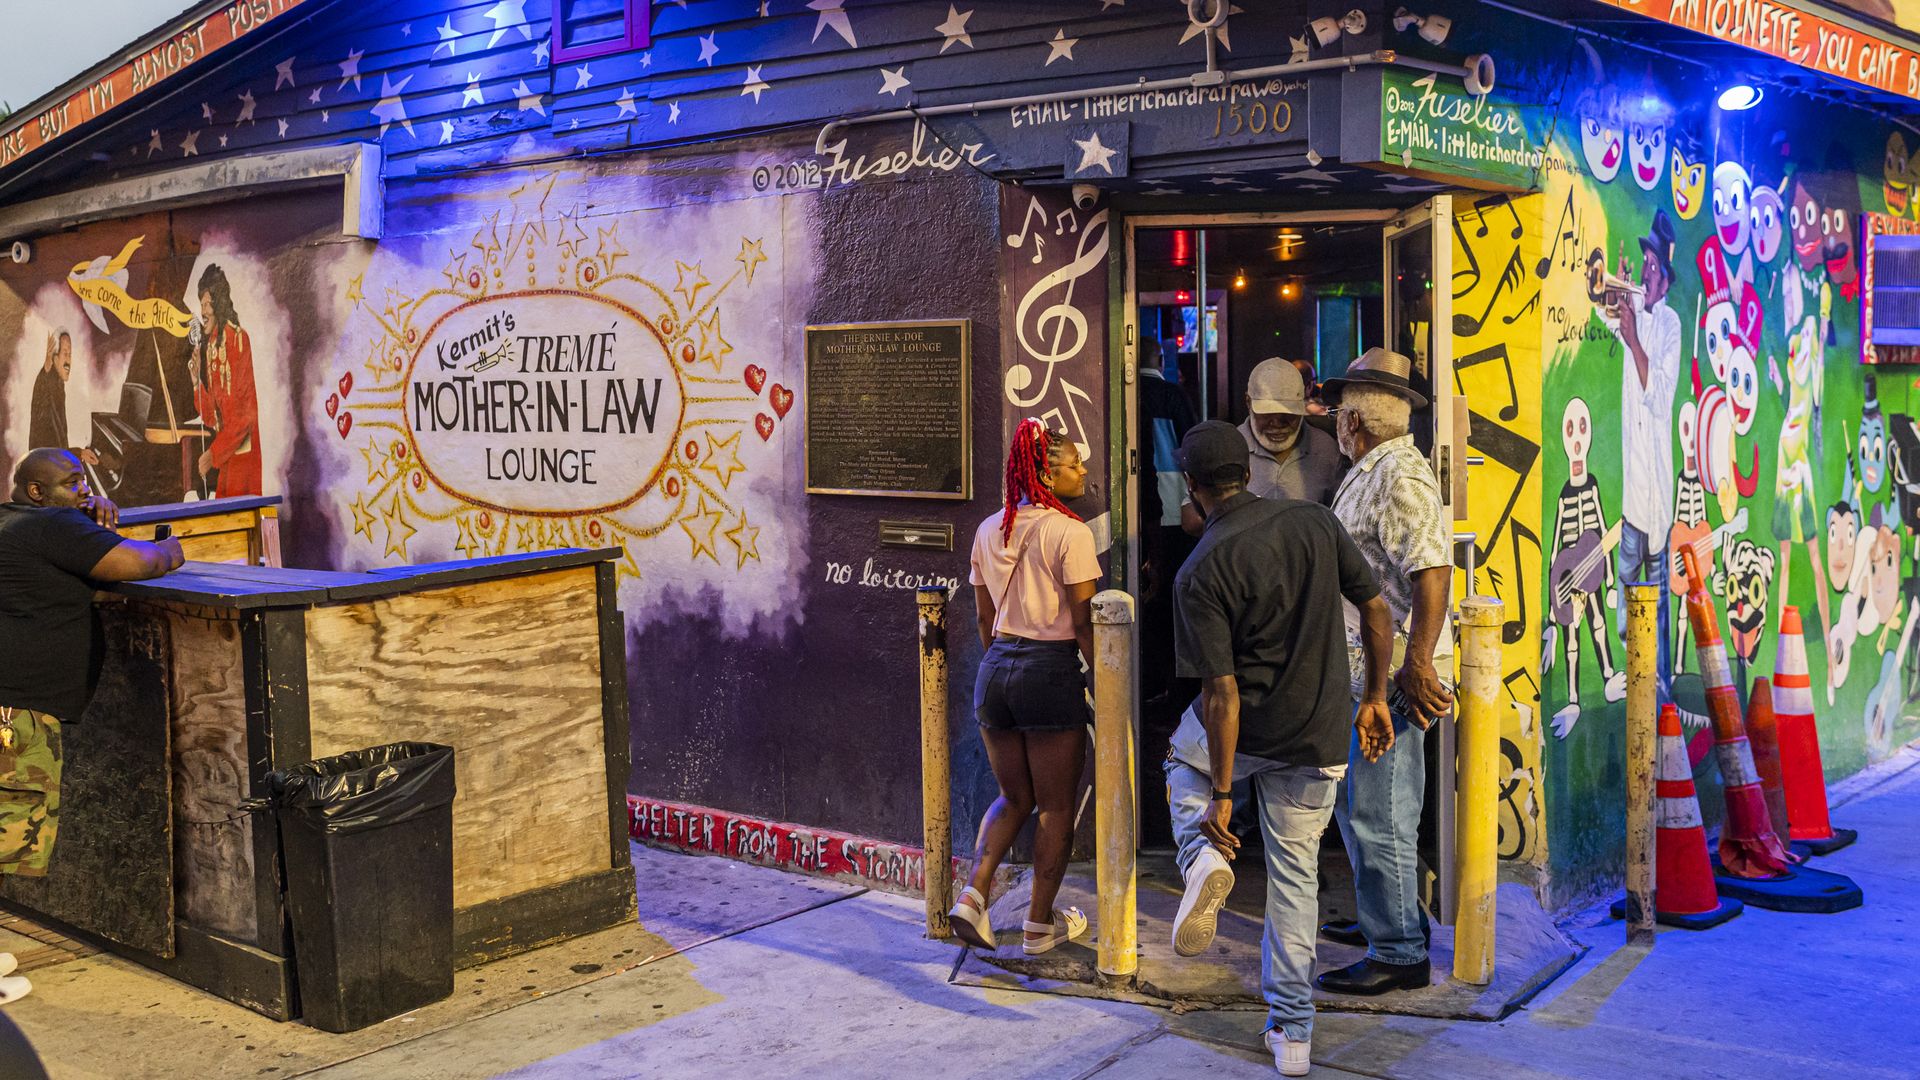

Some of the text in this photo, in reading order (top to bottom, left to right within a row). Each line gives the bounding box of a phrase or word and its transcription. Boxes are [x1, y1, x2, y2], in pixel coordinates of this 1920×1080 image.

[1815, 26, 1854, 76] YOU
[39, 101, 71, 143] BUT
[88, 79, 114, 116] I'M
[130, 21, 208, 95] ALMOST
[1411, 72, 1521, 135] Fuselier
[1214, 100, 1292, 138] 1500
[821, 117, 997, 194] Fuselier
[97, 286, 122, 311] come
[129, 303, 146, 325] the
[1546, 305, 1566, 324] no
[436, 310, 516, 371] Kermit's
[516, 321, 618, 374] TREMÉ
[826, 342, 942, 355] MOTHER-IN-LAW LOUNGE
[843, 332, 925, 344] THE ERNIE K-DOE
[1557, 312, 1621, 358] loitering
[413, 374, 663, 434] MOTHER-IN-LAW
[485, 447, 598, 485] LOUNGE
[824, 556, 961, 602] no loitering
[627, 800, 924, 889] HELTER FROM THE STORM
